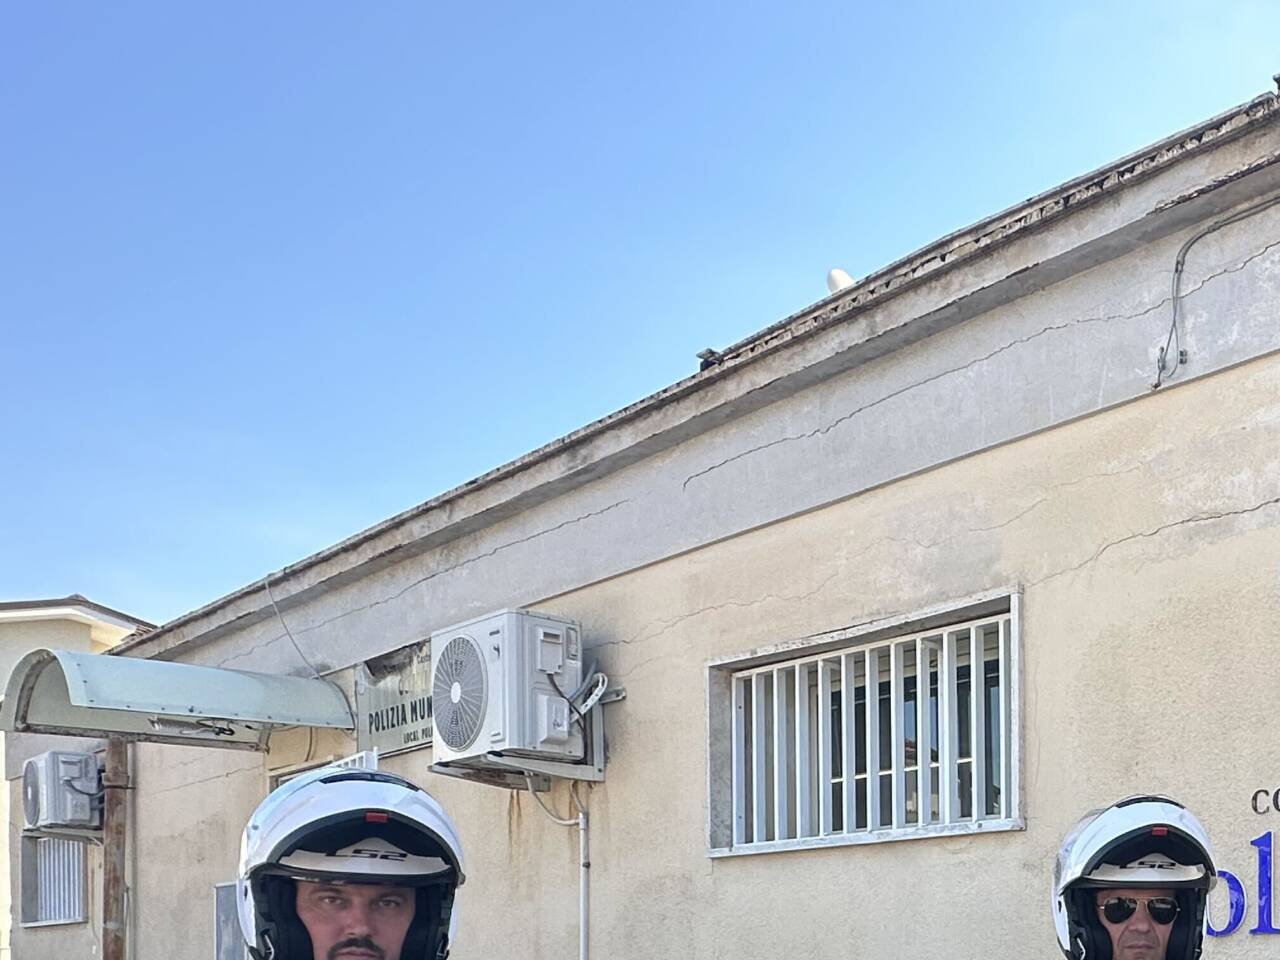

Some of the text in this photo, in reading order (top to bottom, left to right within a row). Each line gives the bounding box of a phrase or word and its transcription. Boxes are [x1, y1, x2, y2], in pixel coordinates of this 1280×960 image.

[369, 695, 433, 734] POLIZIA MUN
[403, 730, 419, 744] LOCAL
